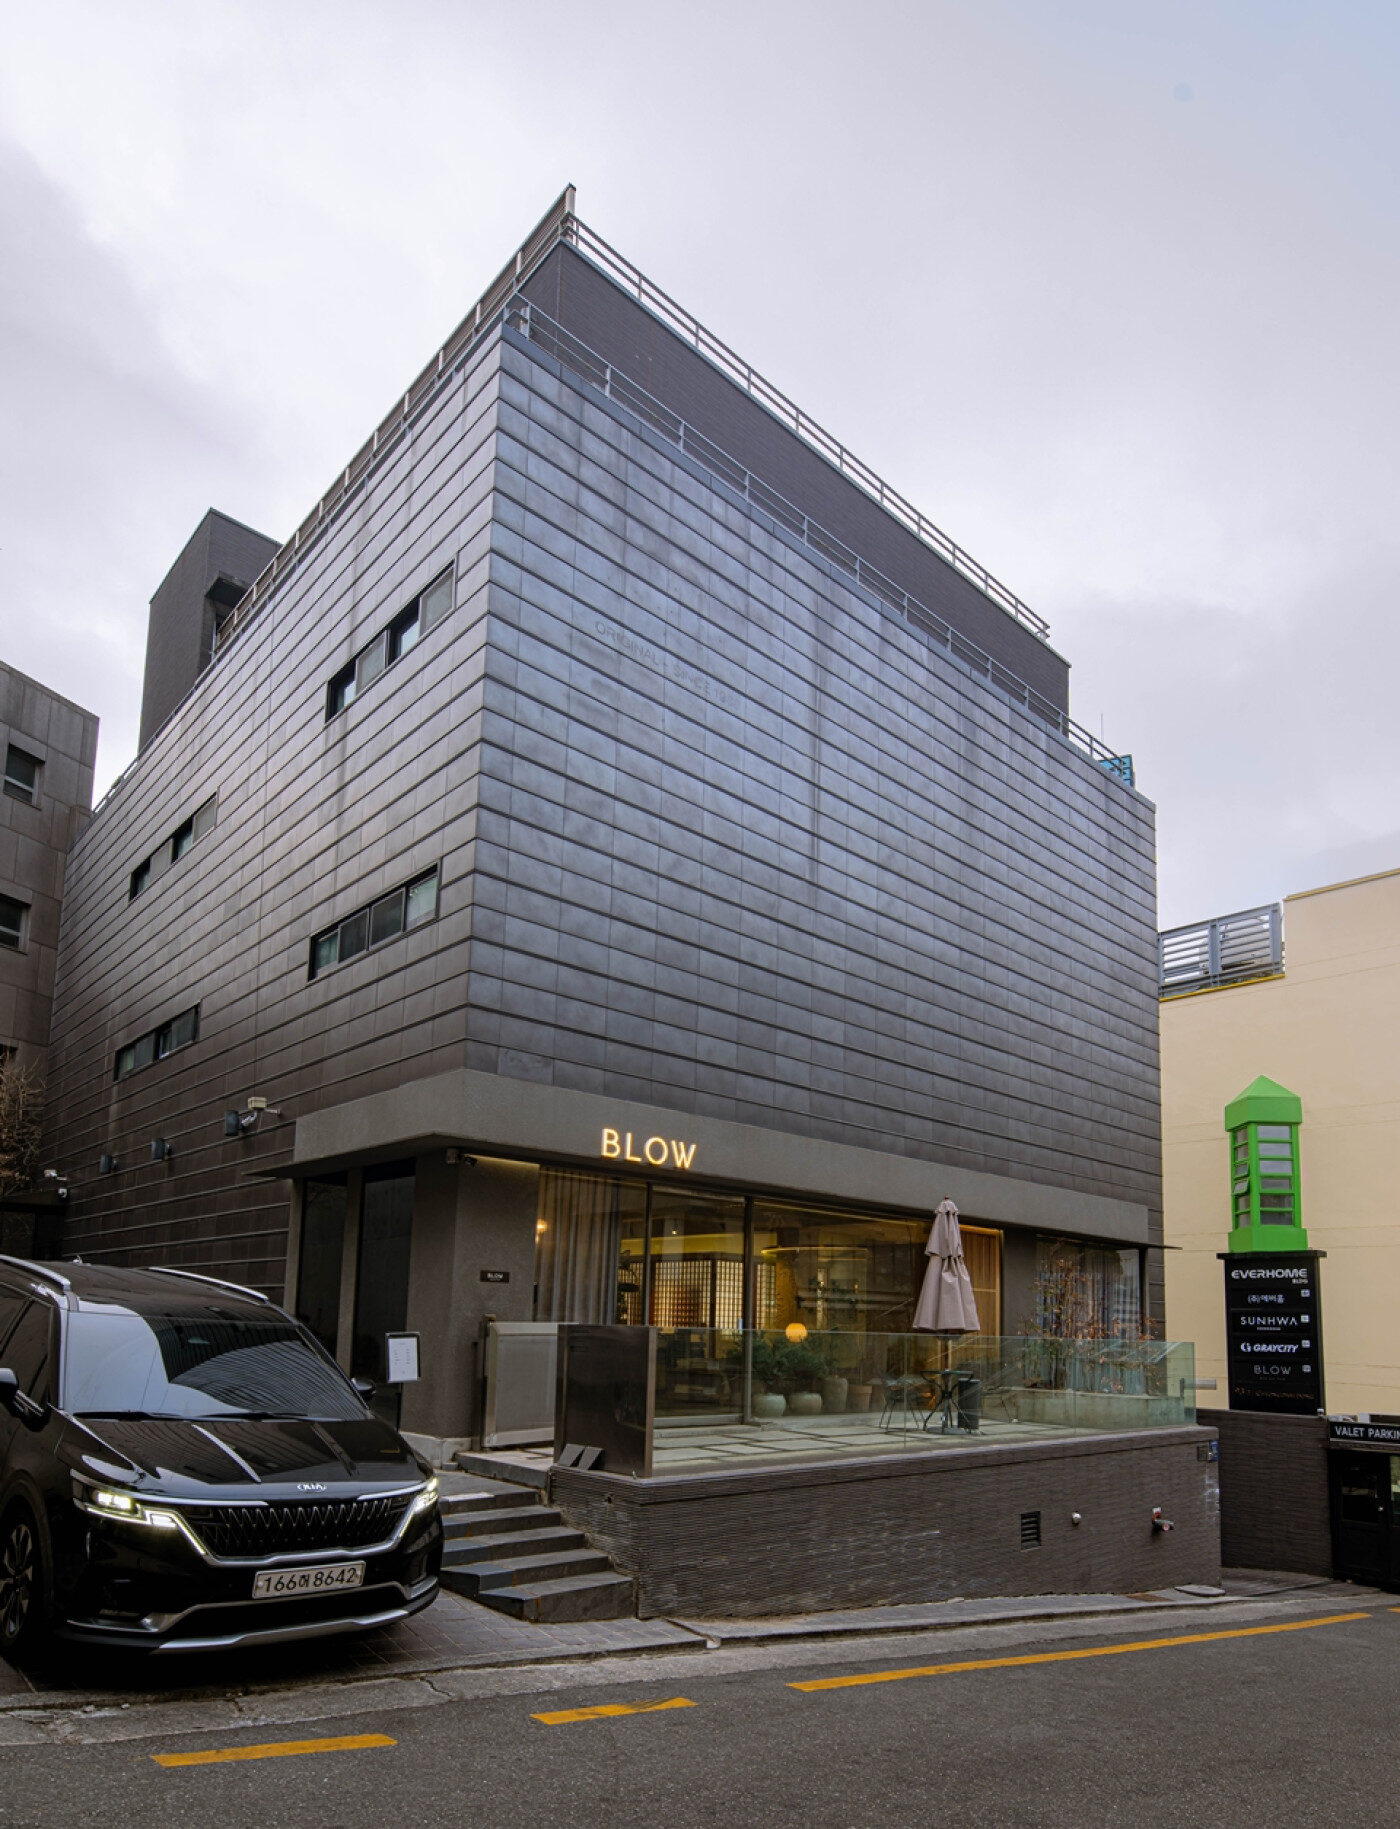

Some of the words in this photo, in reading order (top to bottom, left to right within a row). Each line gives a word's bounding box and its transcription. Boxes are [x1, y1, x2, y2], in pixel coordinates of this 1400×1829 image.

[595, 621, 661, 666] ORIGINAL
[601, 1127, 697, 1169] BLOW
[1231, 1268, 1308, 1279] EVERHOME
[1240, 1316, 1298, 1326] SUNHWA
[1253, 1343, 1299, 1353] GRAYCITY
[1253, 1364, 1292, 1375] BLOW
[1335, 1425, 1365, 1438] VALET
